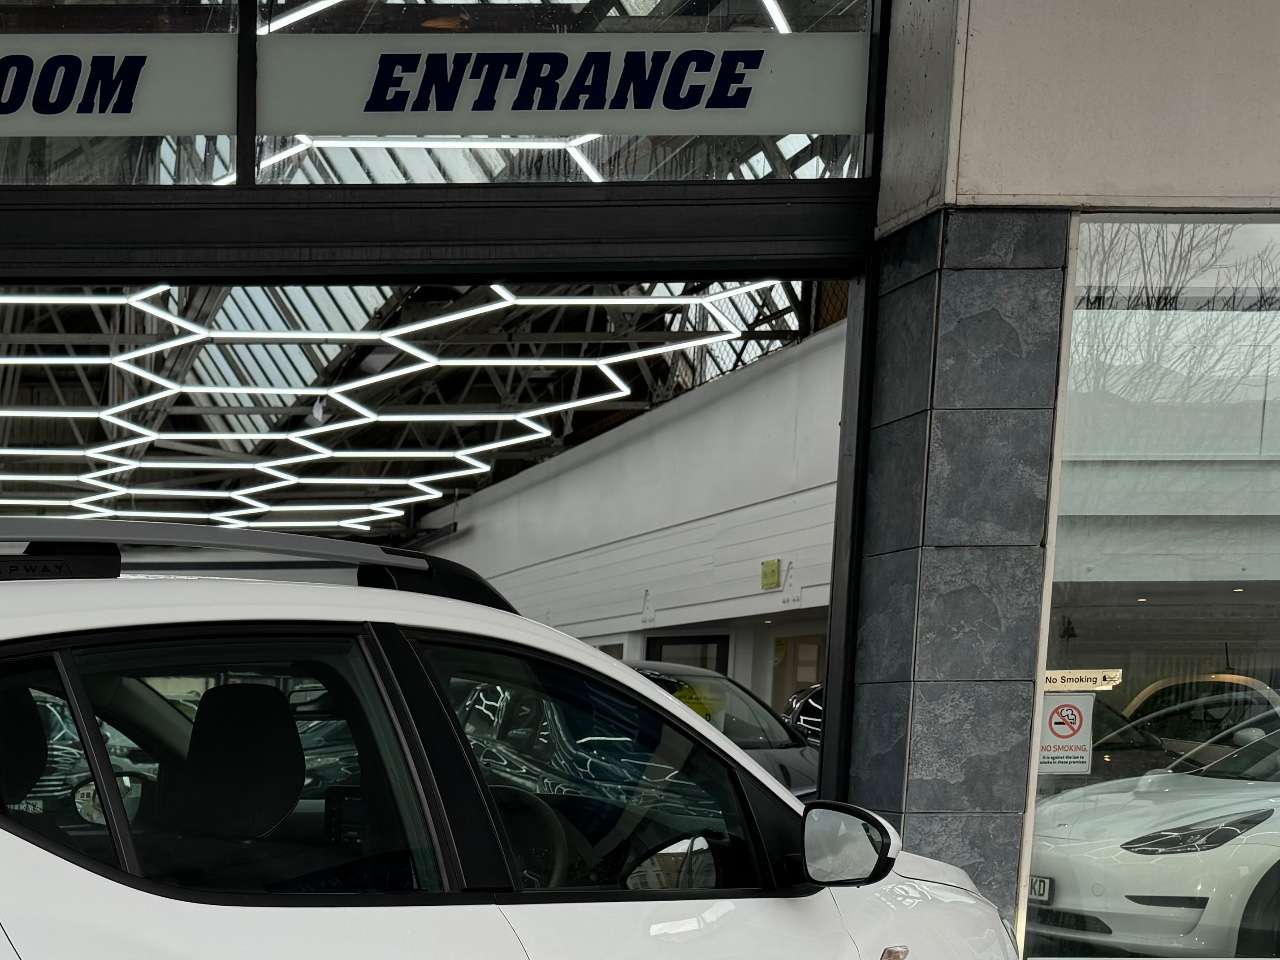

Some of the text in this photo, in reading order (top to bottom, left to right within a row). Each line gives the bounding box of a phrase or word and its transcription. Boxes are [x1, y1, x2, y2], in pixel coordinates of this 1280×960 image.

[362, 48, 766, 113] ENTRANCE
[1045, 675, 1098, 685] No Smoking
[1040, 744, 1052, 752] NO
[1030, 878, 1046, 897] KD
